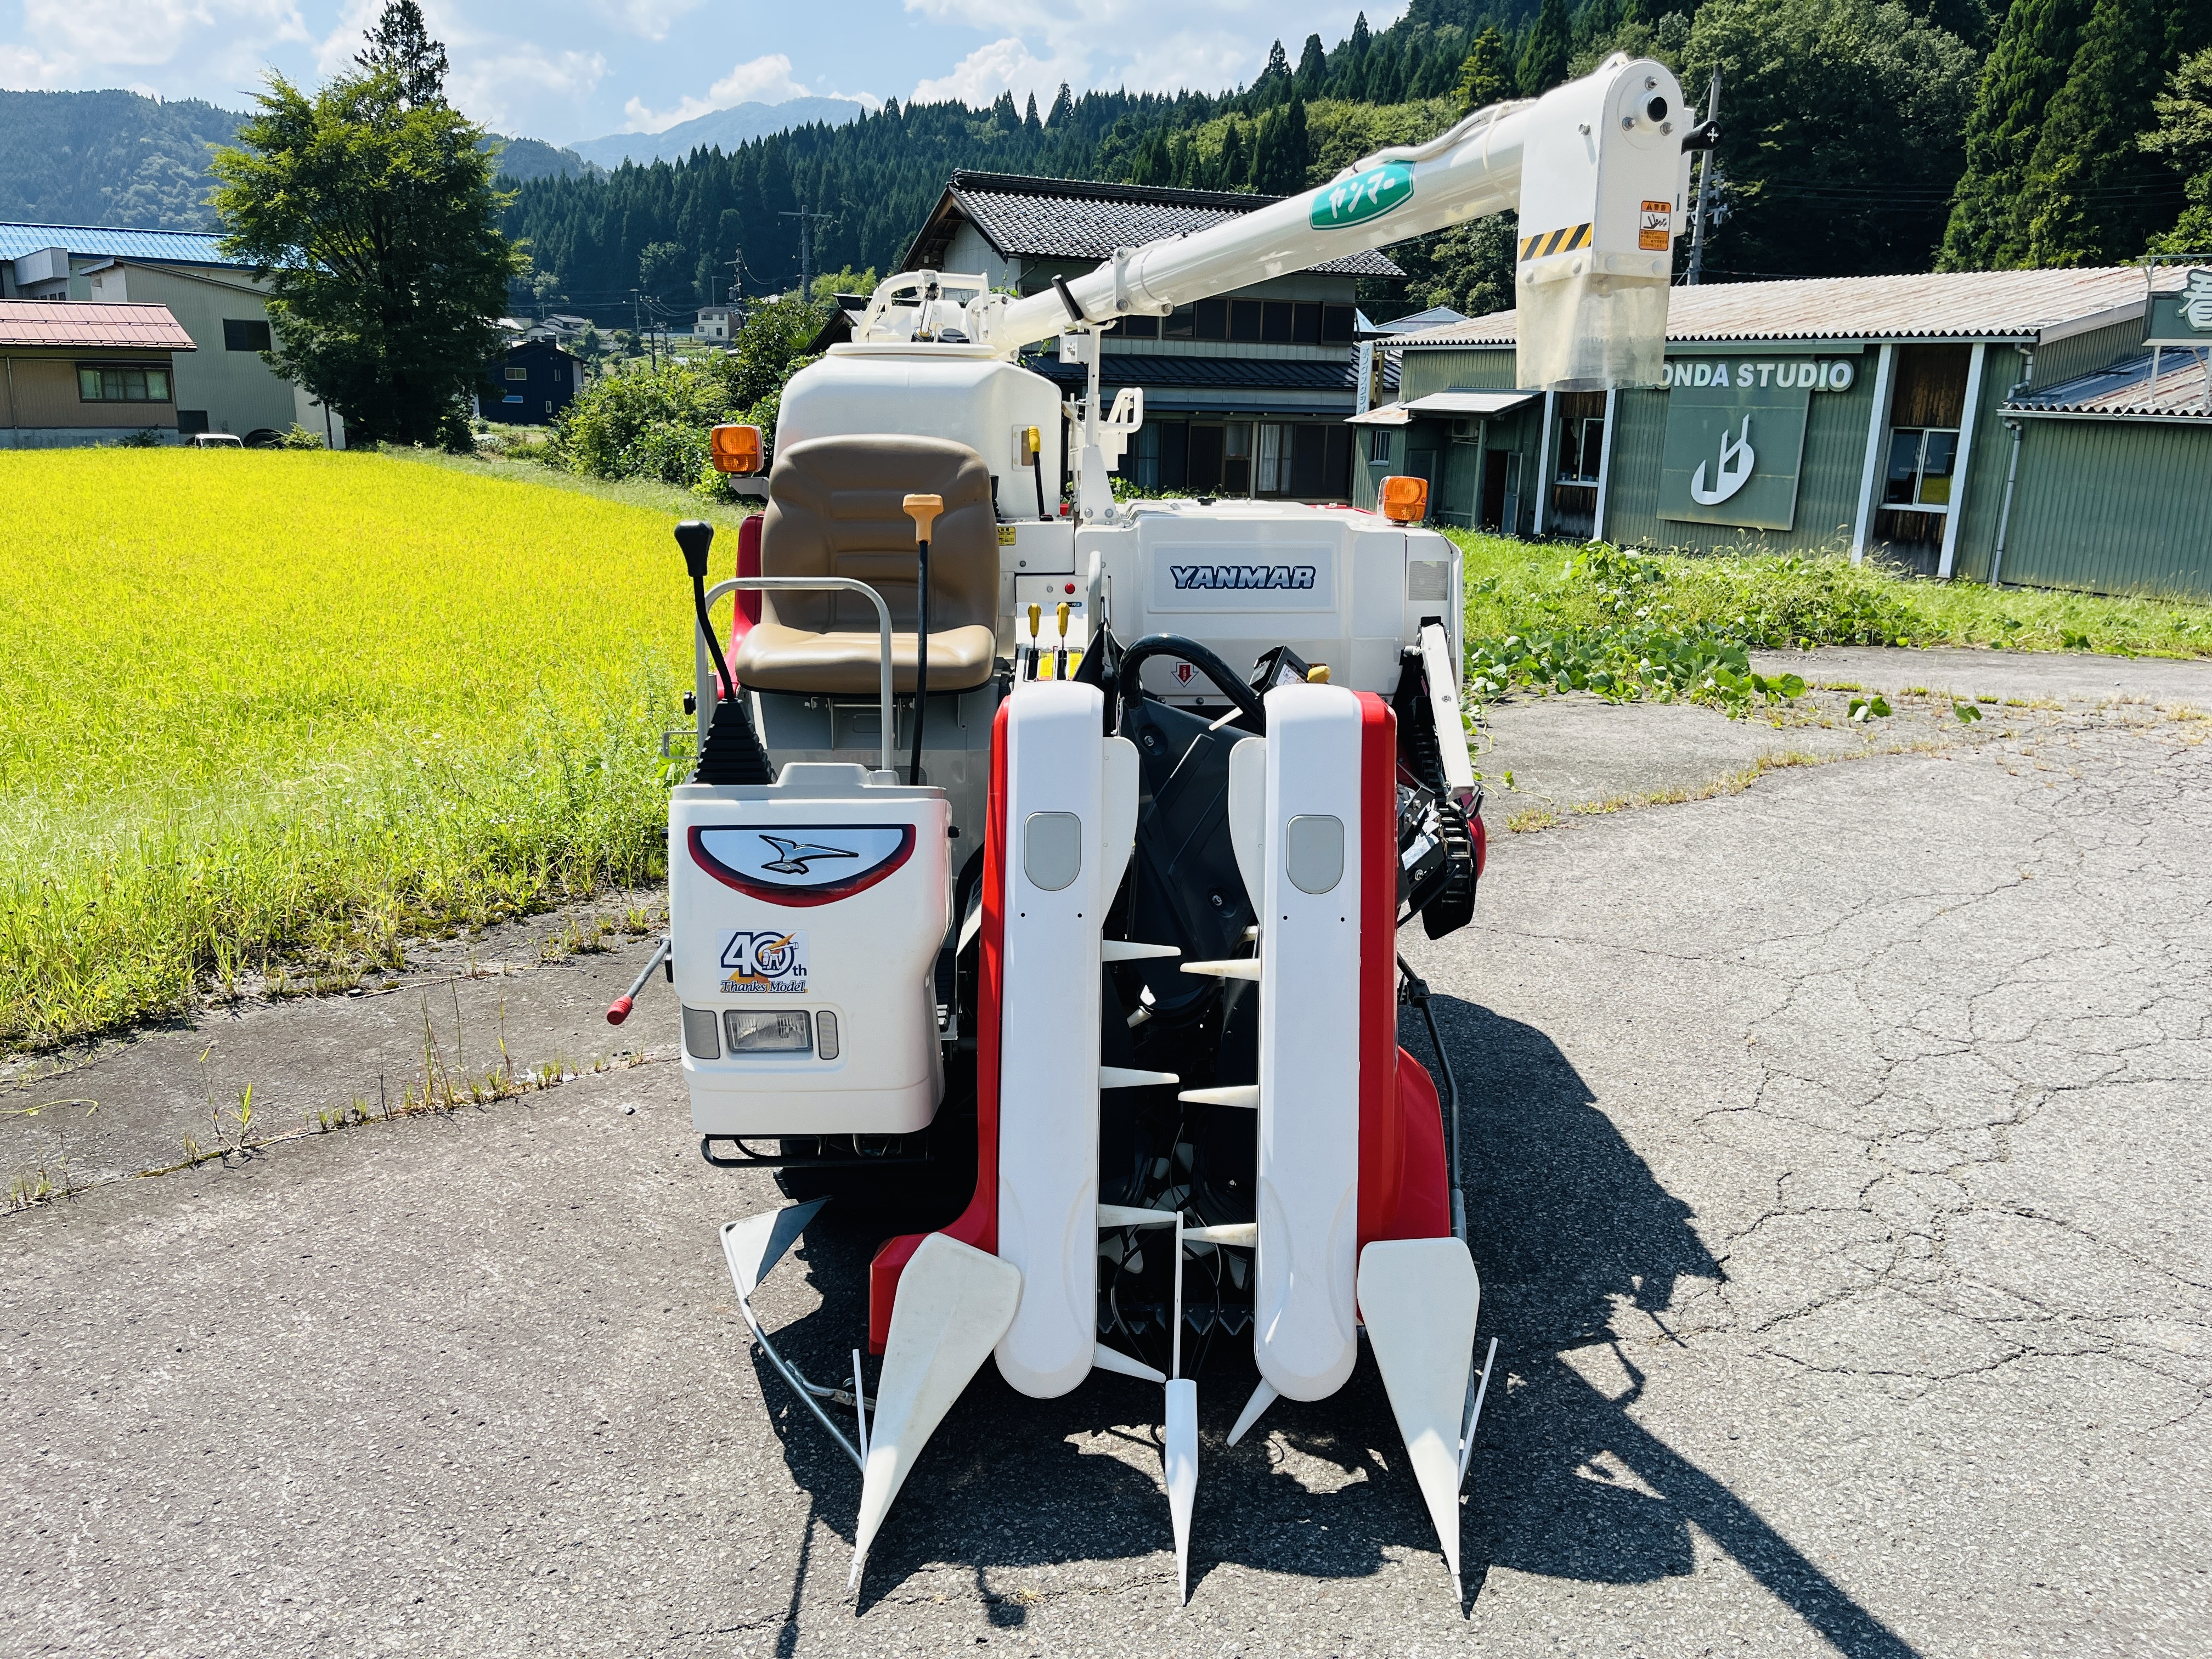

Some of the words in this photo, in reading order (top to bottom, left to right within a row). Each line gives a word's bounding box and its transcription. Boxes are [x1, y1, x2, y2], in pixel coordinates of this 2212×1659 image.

[1329, 171, 1395, 218] ヤンマー
[1661, 363, 1729, 387] ONDA
[1736, 363, 1852, 388] STUDIO
[1170, 566, 1316, 589] YANMAR
[721, 932, 807, 978] 40th
[721, 980, 766, 992] Thanks
[769, 980, 805, 992] Model
